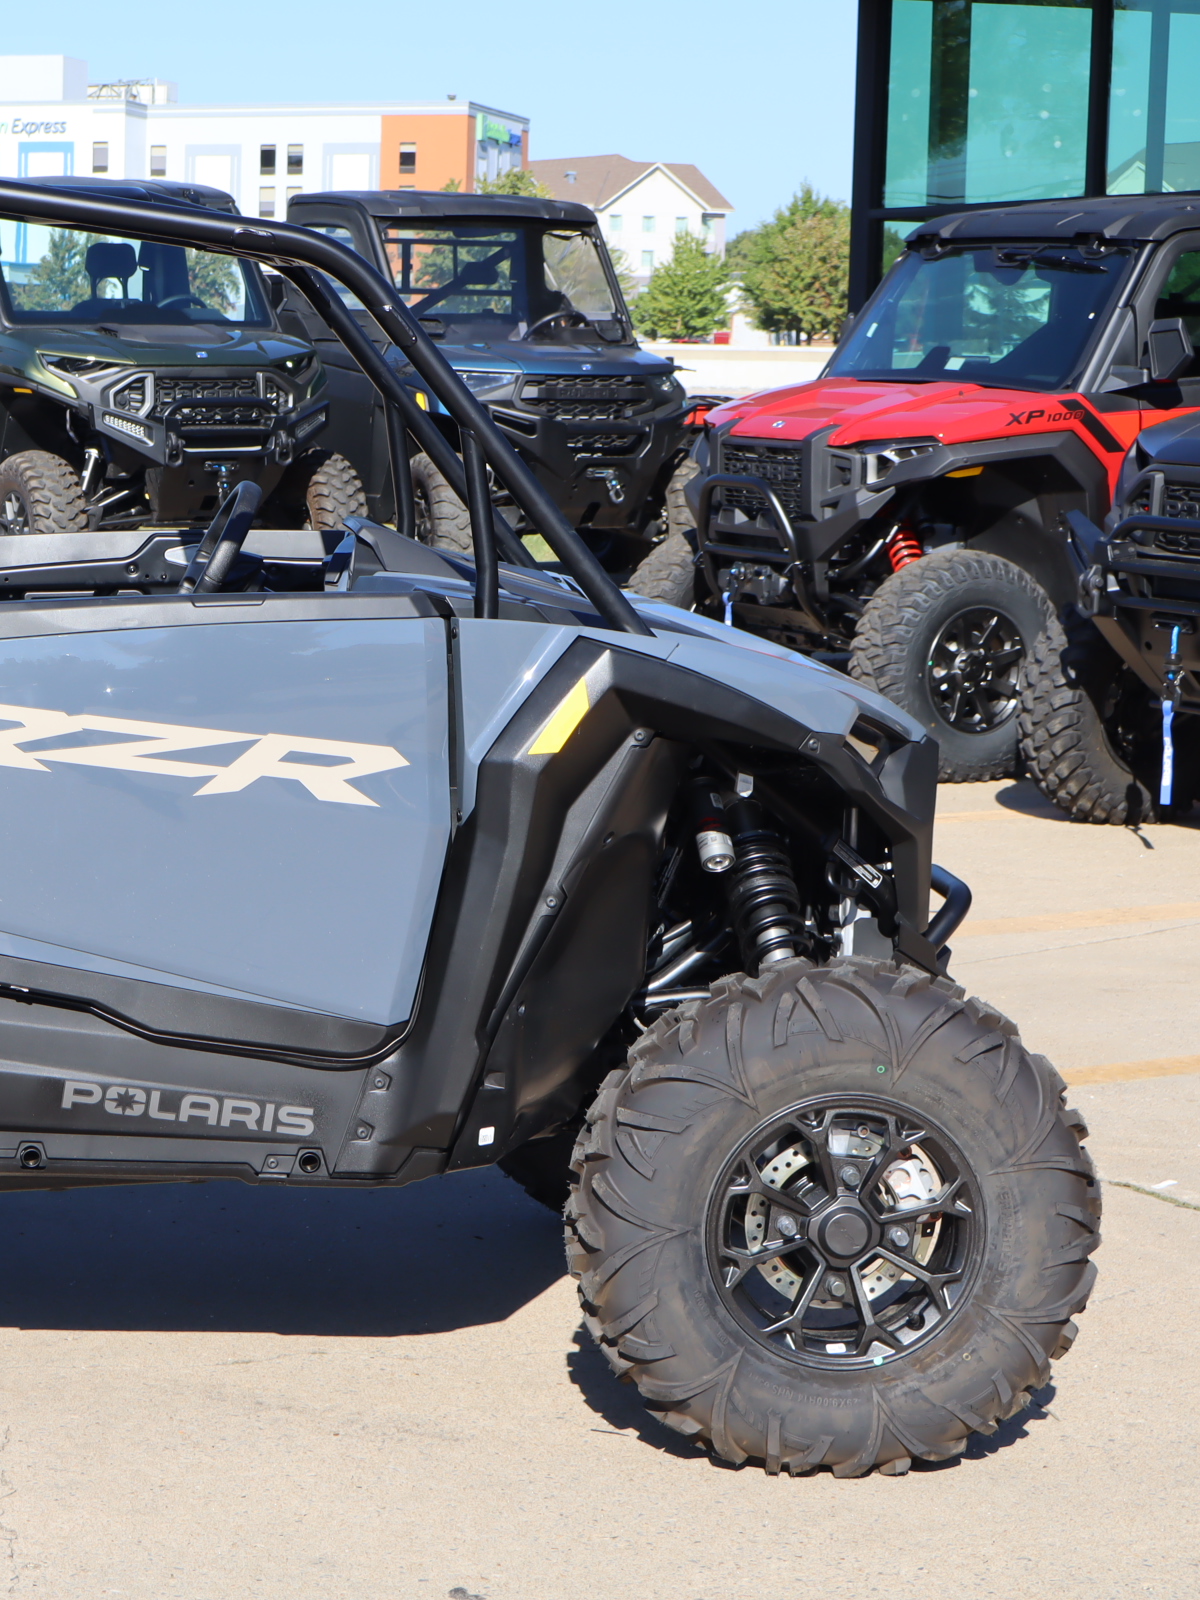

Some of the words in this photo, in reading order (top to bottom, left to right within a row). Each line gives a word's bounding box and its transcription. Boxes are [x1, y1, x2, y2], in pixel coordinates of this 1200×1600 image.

[11, 118, 67, 137] Express
[1004, 409, 1046, 427] XP
[1046, 409, 1085, 423] 1000
[61, 1080, 315, 1137] POLARIS
